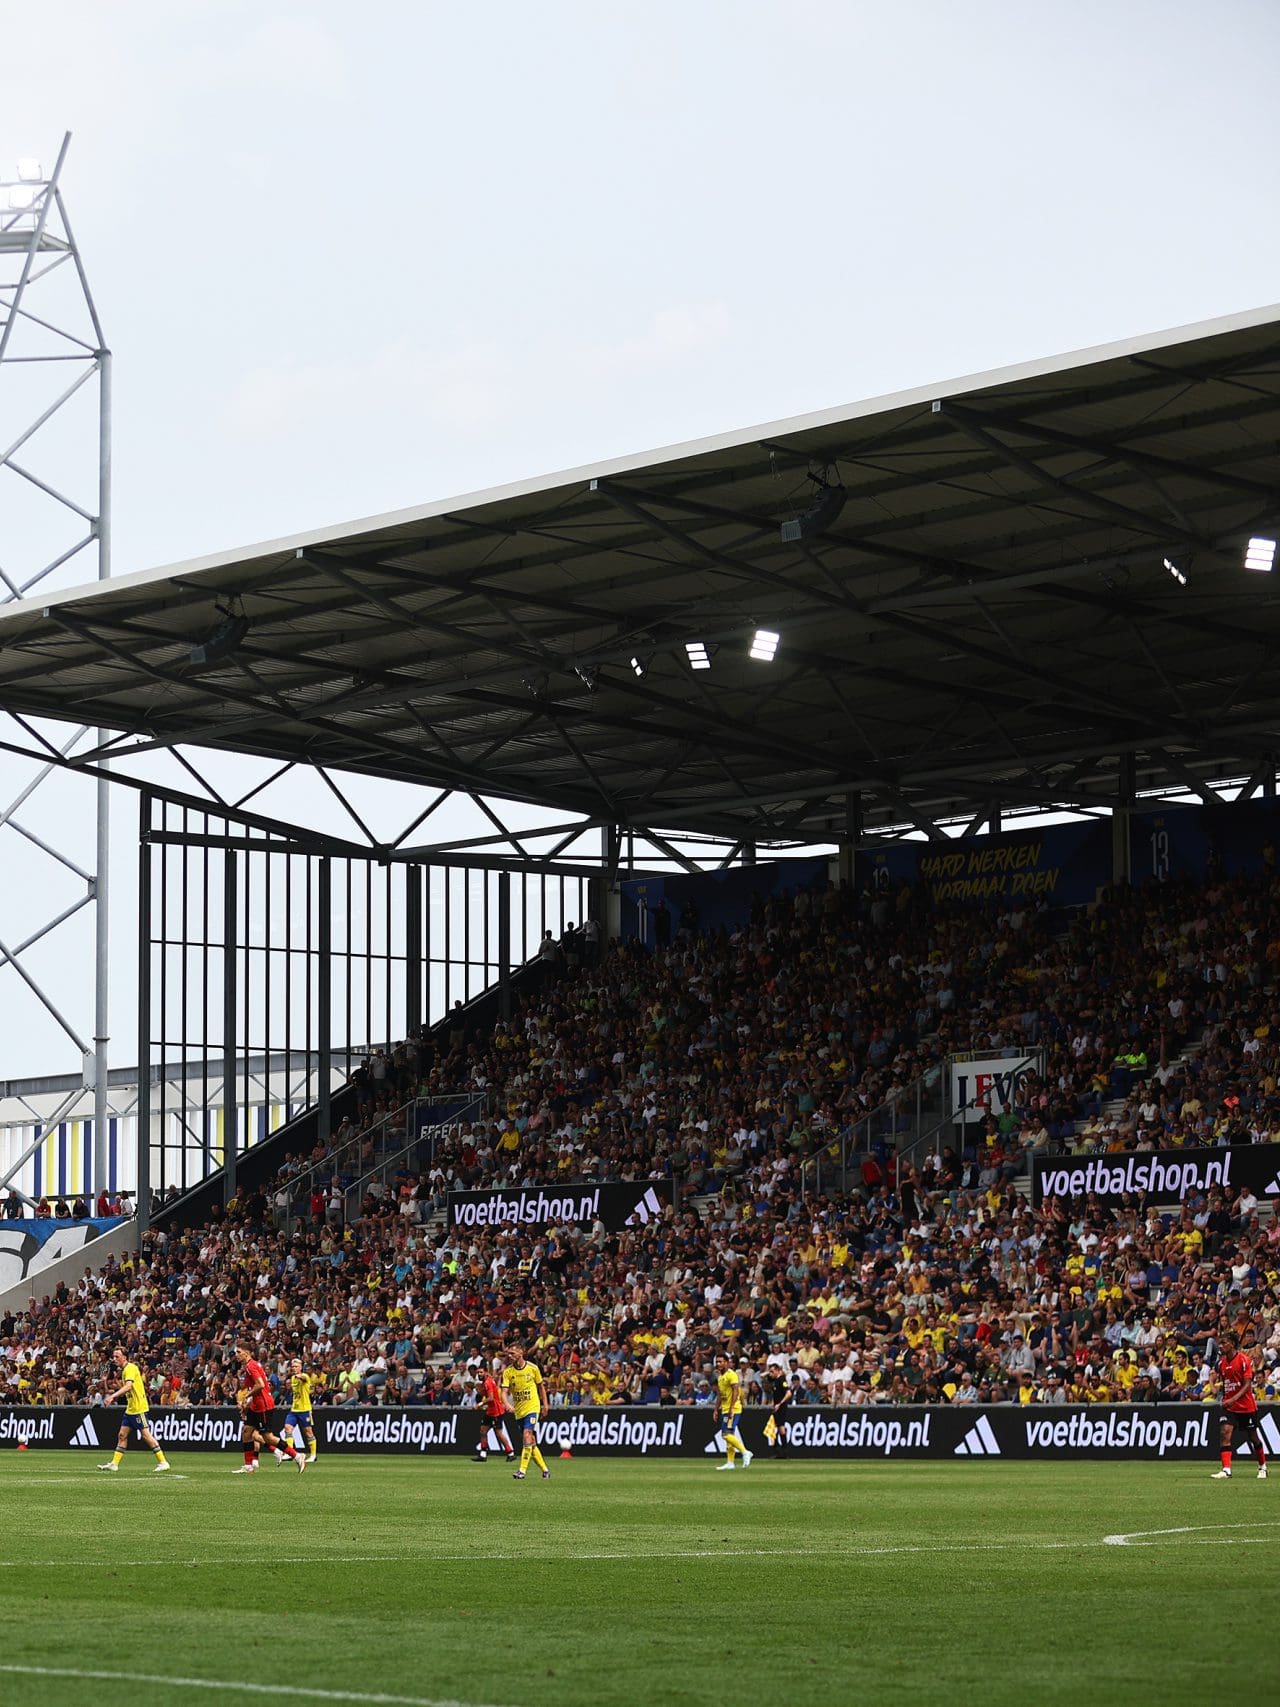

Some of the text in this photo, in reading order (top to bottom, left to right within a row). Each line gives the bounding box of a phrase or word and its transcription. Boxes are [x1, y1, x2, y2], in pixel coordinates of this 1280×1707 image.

[967, 843, 1041, 874] WERKEN
[1011, 868, 1059, 897] DOEN
[1041, 1151, 1231, 1200] voetbalshop.nl
[454, 1188, 600, 1225] voetbalshop.nl
[326, 1413, 457, 1451] voetbalshop.nl
[536, 1413, 684, 1453] voetbalshop.nl
[1025, 1411, 1209, 1456] voetbalshop.nl
